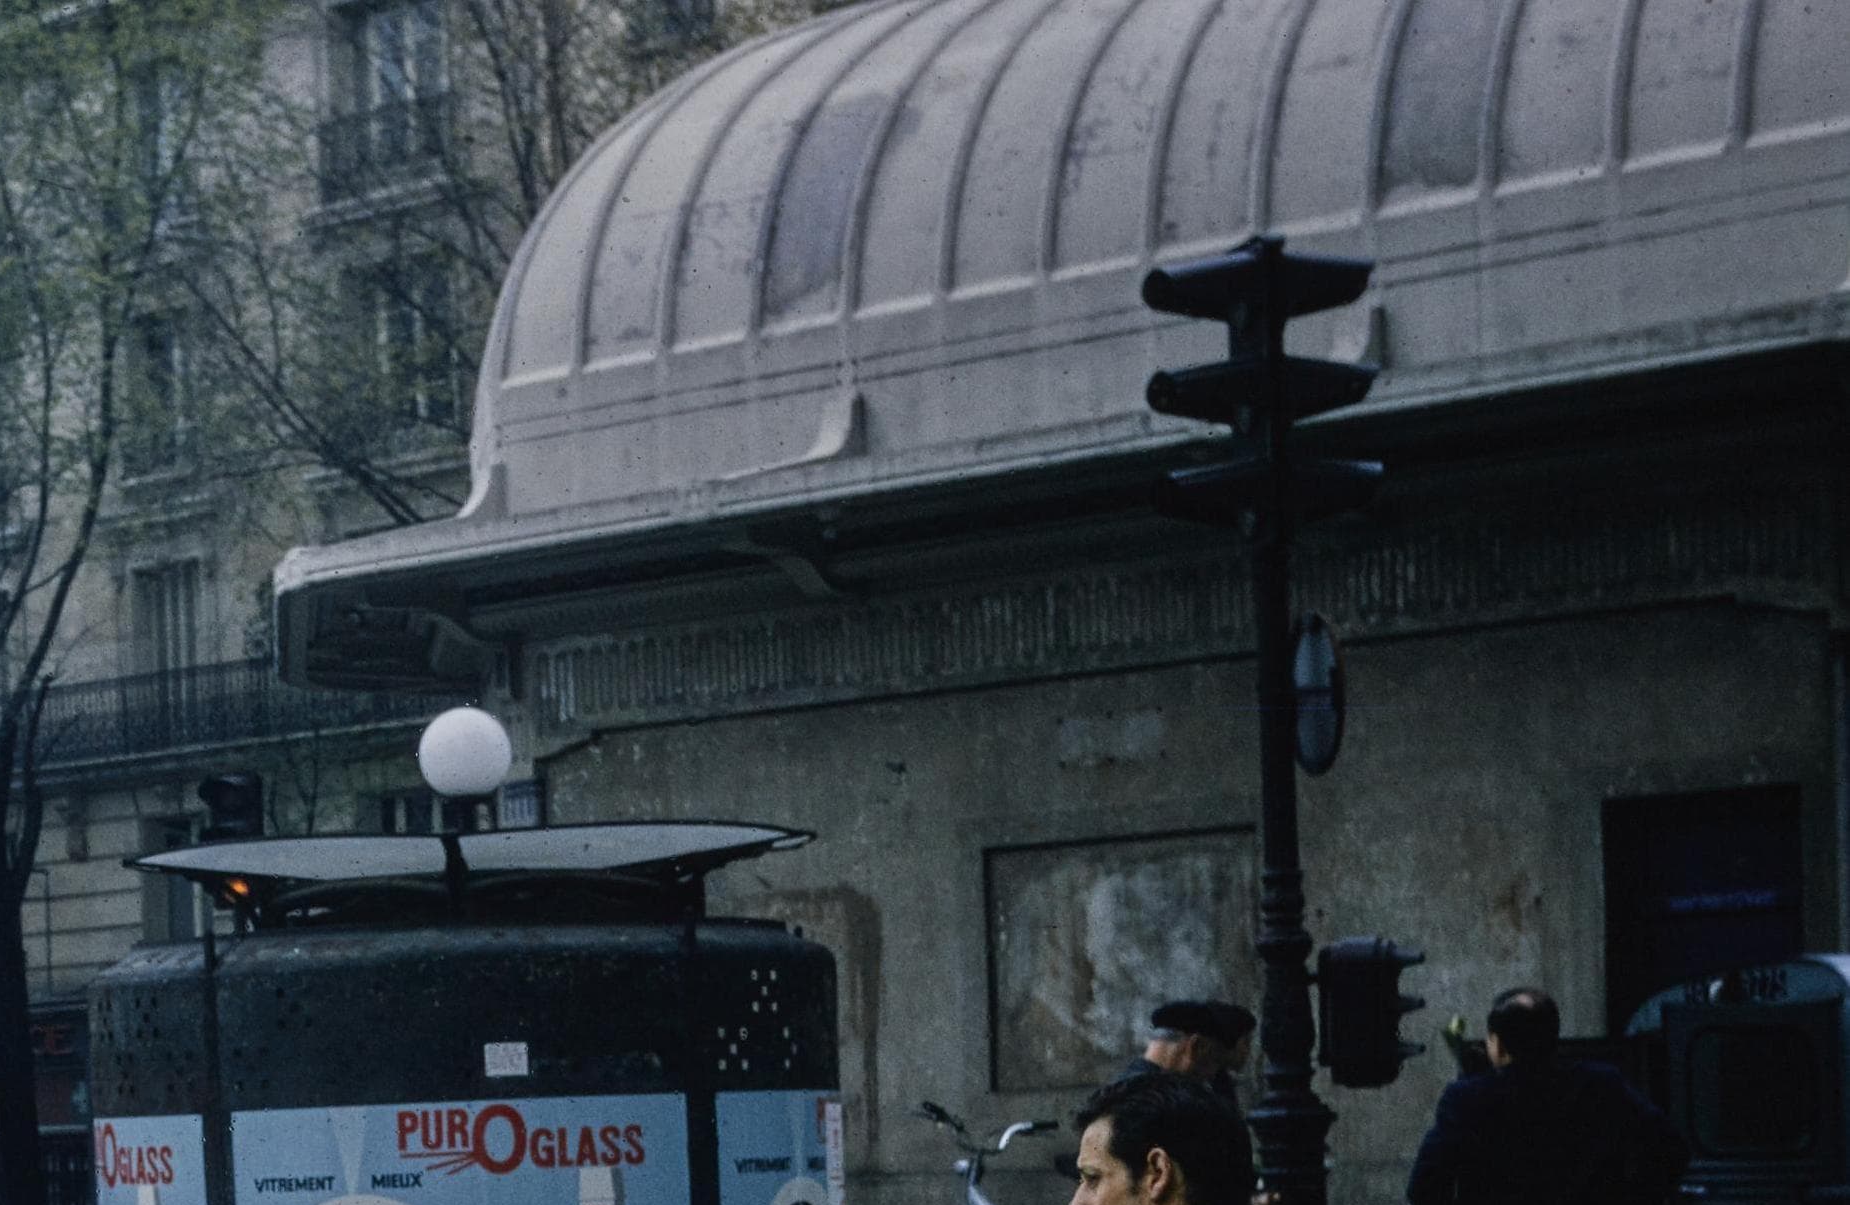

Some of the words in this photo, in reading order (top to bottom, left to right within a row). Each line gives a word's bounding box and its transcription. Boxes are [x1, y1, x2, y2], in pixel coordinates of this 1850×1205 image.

[97, 1122, 173, 1188] OGLASS
[397, 1103, 645, 1175] PUROGLASS
[371, 1172, 423, 1190] MIEUX
